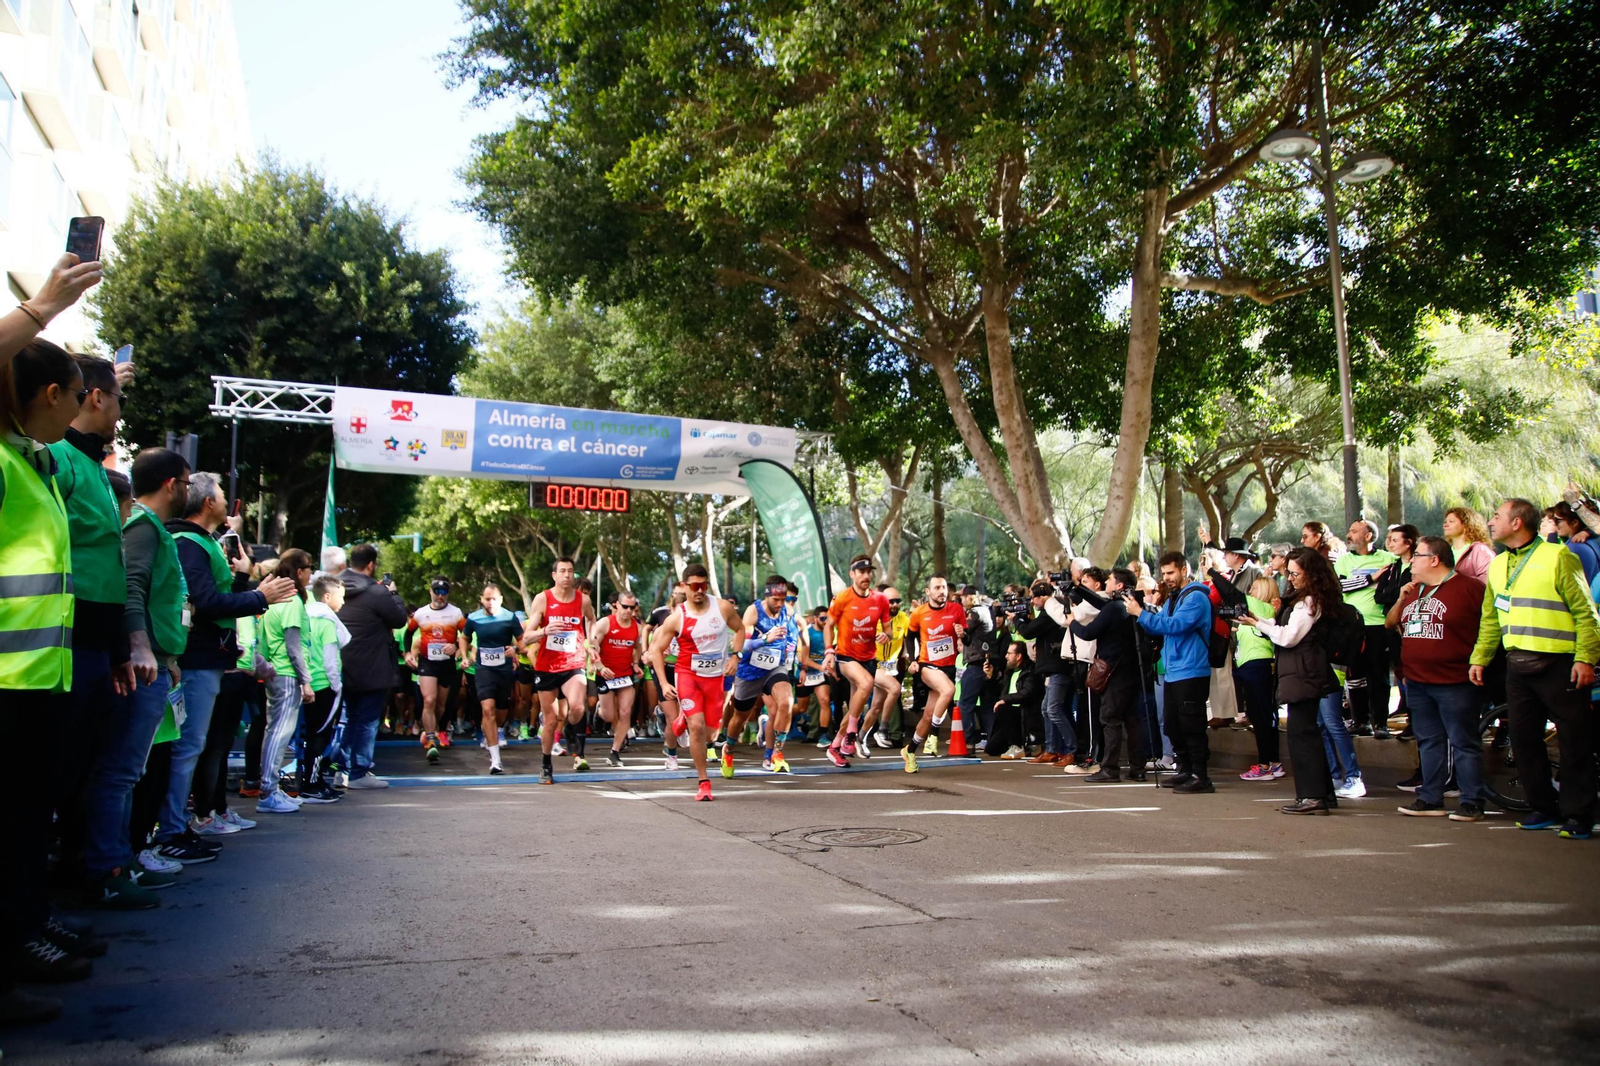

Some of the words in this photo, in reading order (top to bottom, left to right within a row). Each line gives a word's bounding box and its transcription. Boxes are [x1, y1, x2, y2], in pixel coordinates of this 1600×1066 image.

[489, 408, 566, 430] Almería
[572, 417, 595, 432] en
[601, 420, 670, 439] marcha
[487, 433, 552, 451] contra
[557, 436, 577, 452] el
[581, 437, 647, 458] cáncer
[553, 637, 571, 645] 285
[932, 645, 950, 654] 543
[757, 653, 775, 664] 570
[698, 660, 717, 668] 225
